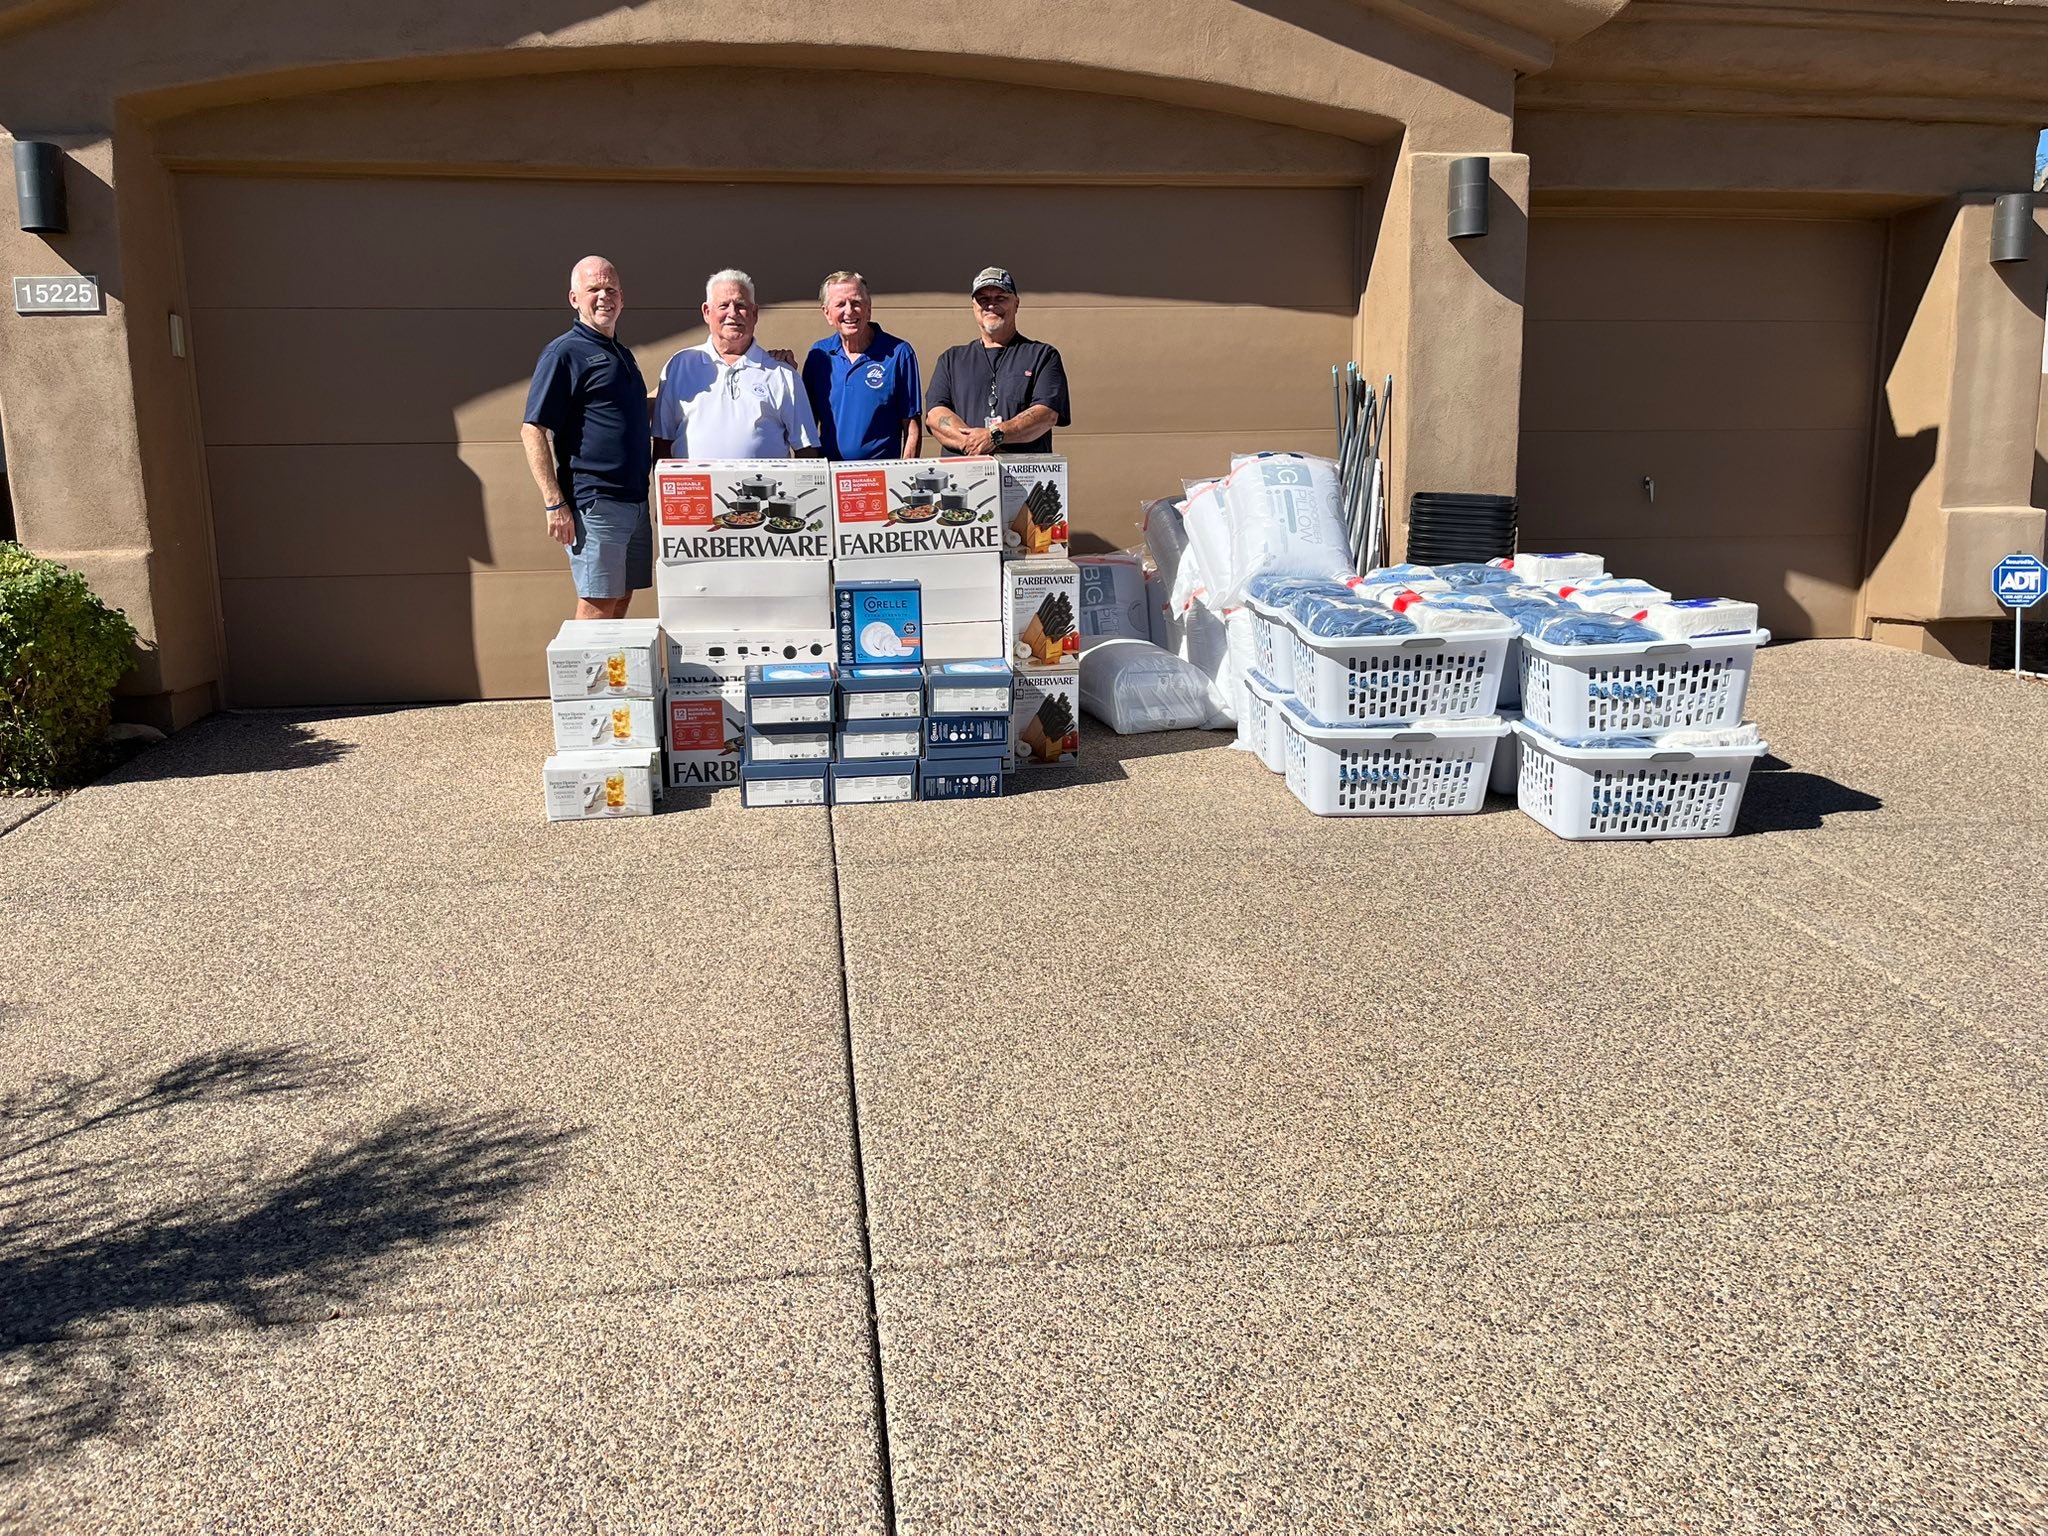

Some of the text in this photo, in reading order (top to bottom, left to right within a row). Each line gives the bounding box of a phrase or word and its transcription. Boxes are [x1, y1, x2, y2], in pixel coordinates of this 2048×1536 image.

[21, 284, 92, 303] 15225
[1007, 464, 1063, 474] FARBERWARE
[664, 483, 674, 491] 12
[1293, 489, 1314, 544] PILLOW
[662, 535, 828, 558] FARBERWARE
[839, 525, 999, 556] FARBERWARE
[1018, 576, 1075, 586] FARBERWARE
[1083, 566, 1104, 605] BIG
[2001, 571, 2040, 591] ADT
[863, 596, 908, 613] CORELLE
[1018, 677, 1075, 687] FARBERWARE
[673, 761, 740, 784] FARB
